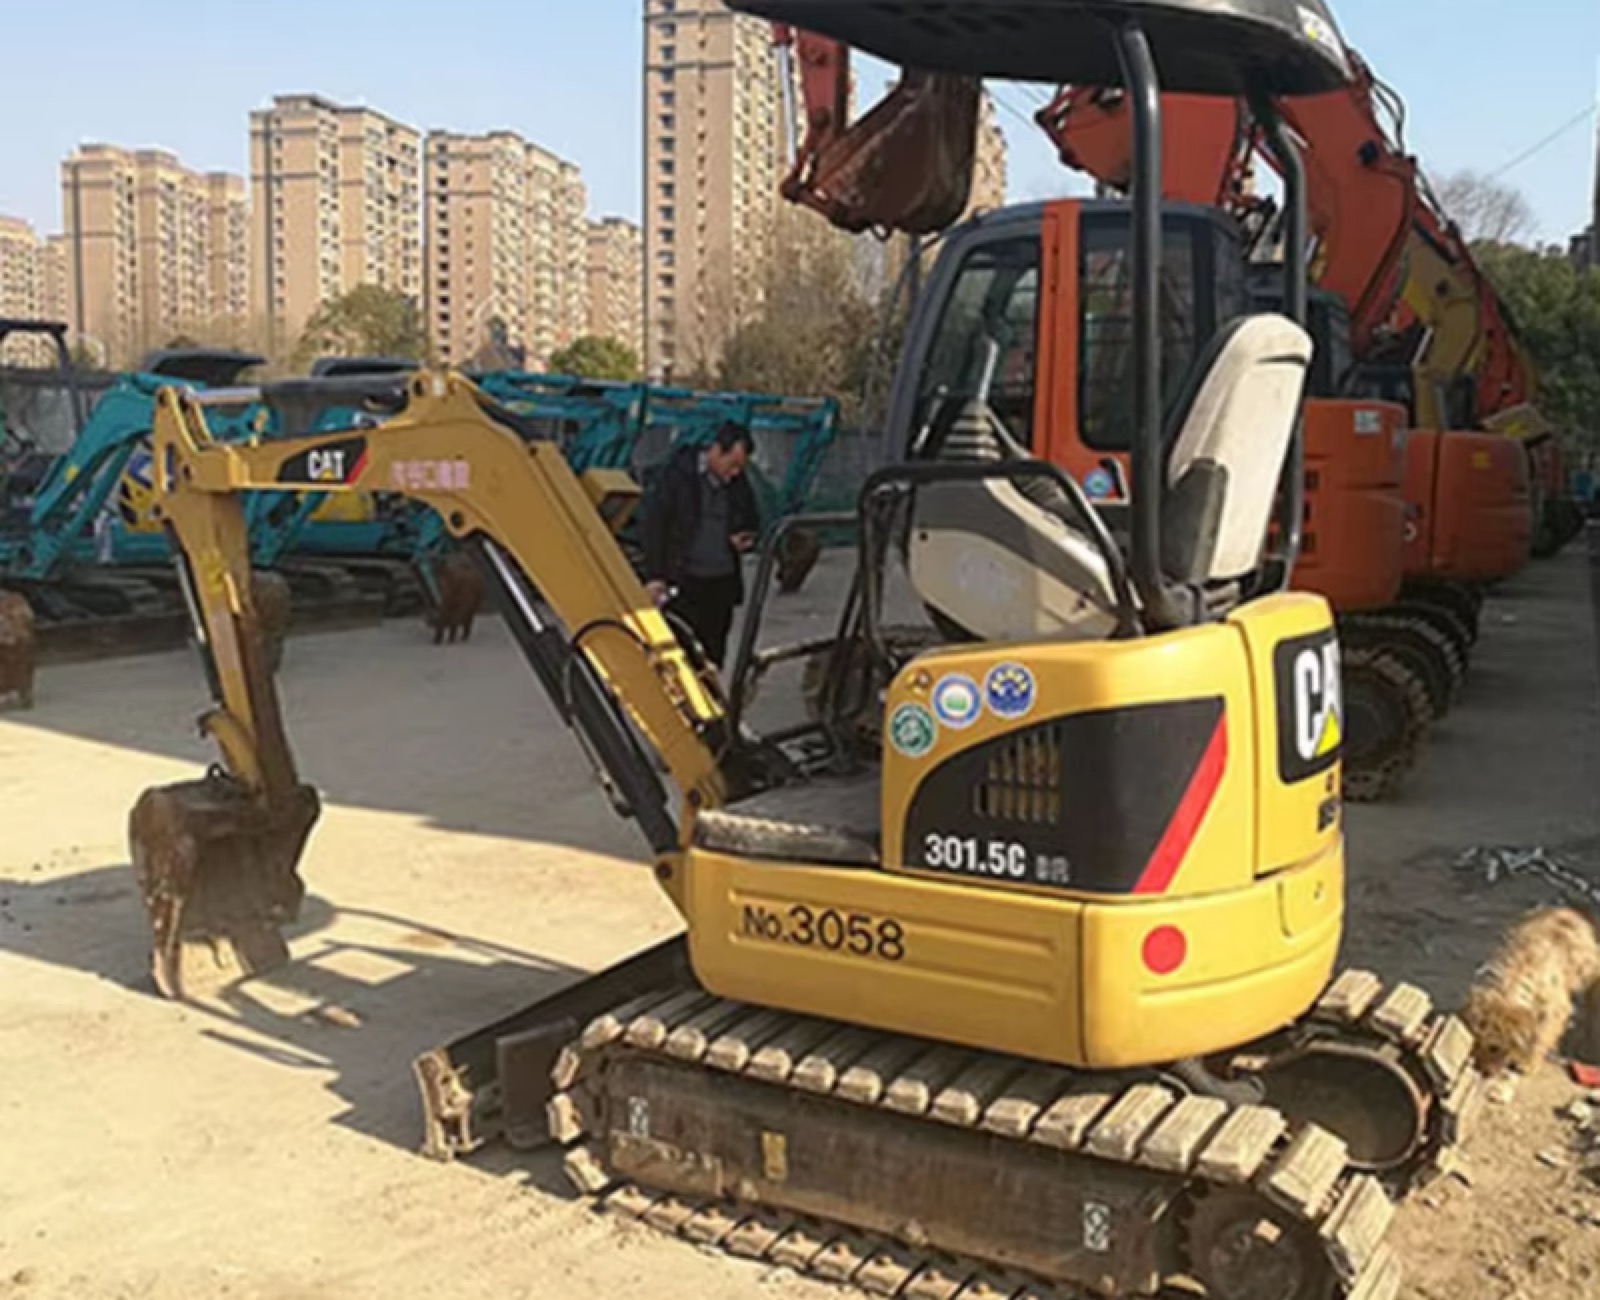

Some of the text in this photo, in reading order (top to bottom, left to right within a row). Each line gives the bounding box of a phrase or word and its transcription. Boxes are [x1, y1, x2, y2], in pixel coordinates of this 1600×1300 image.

[307, 450, 345, 480] CAT
[1294, 638, 1342, 760] CA
[924, 833, 1027, 877] 301.5C
